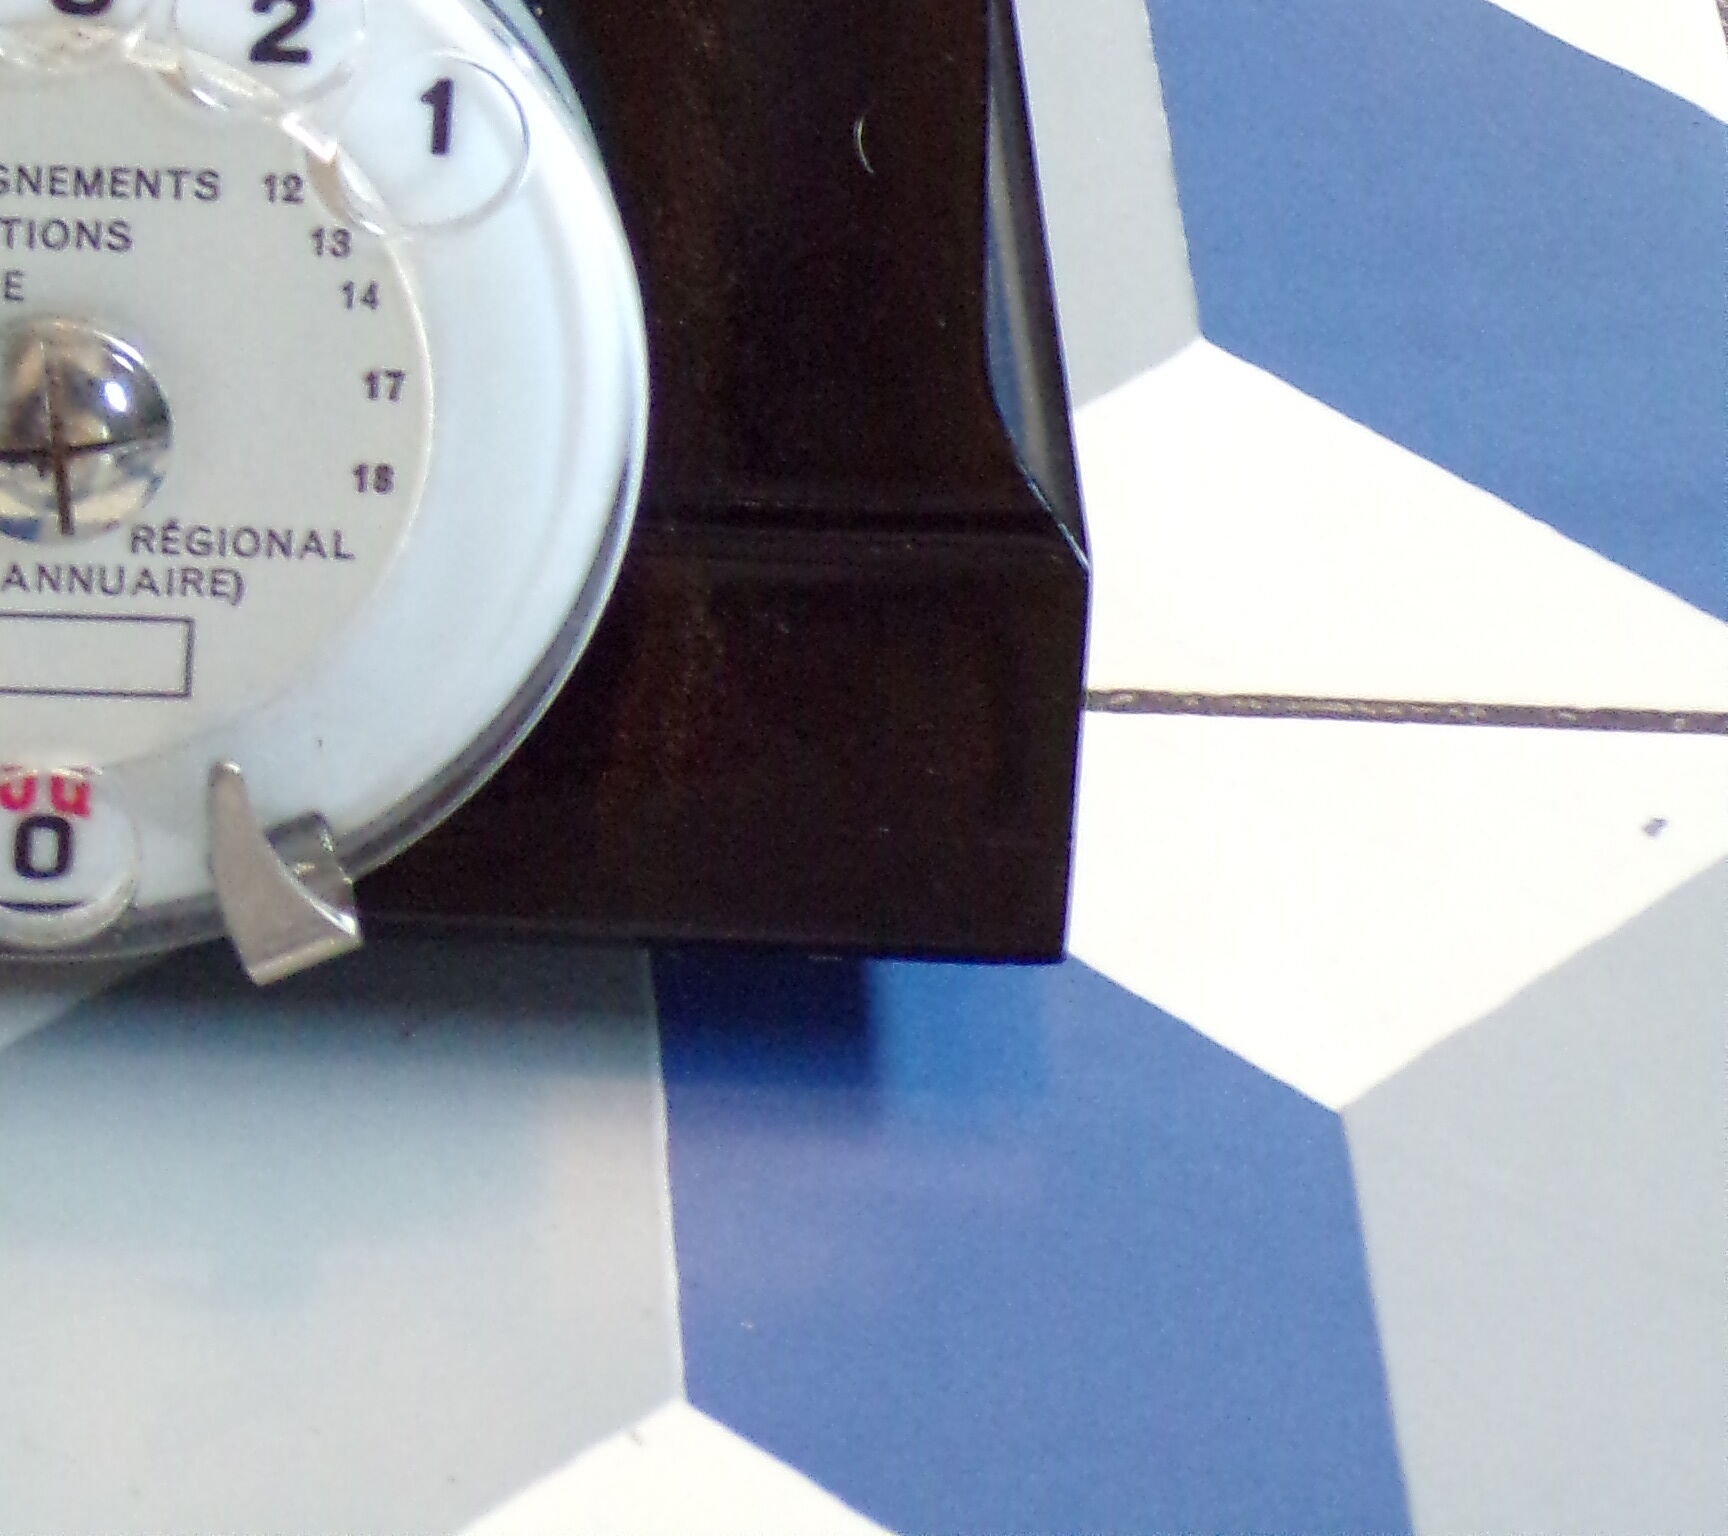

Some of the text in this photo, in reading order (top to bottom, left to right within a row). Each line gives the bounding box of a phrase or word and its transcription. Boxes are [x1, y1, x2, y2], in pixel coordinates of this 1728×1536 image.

[420, 78, 454, 156] 1
[264, 172, 305, 204] 12
[312, 227, 353, 258] 13
[341, 280, 380, 310] 14
[364, 368, 407, 402] 17
[352, 462, 396, 495] 18
[130, 518, 356, 562] RÉGIONAL
[0, 562, 246, 607] ANNUAIRE)
[12, 814, 74, 880] 0
